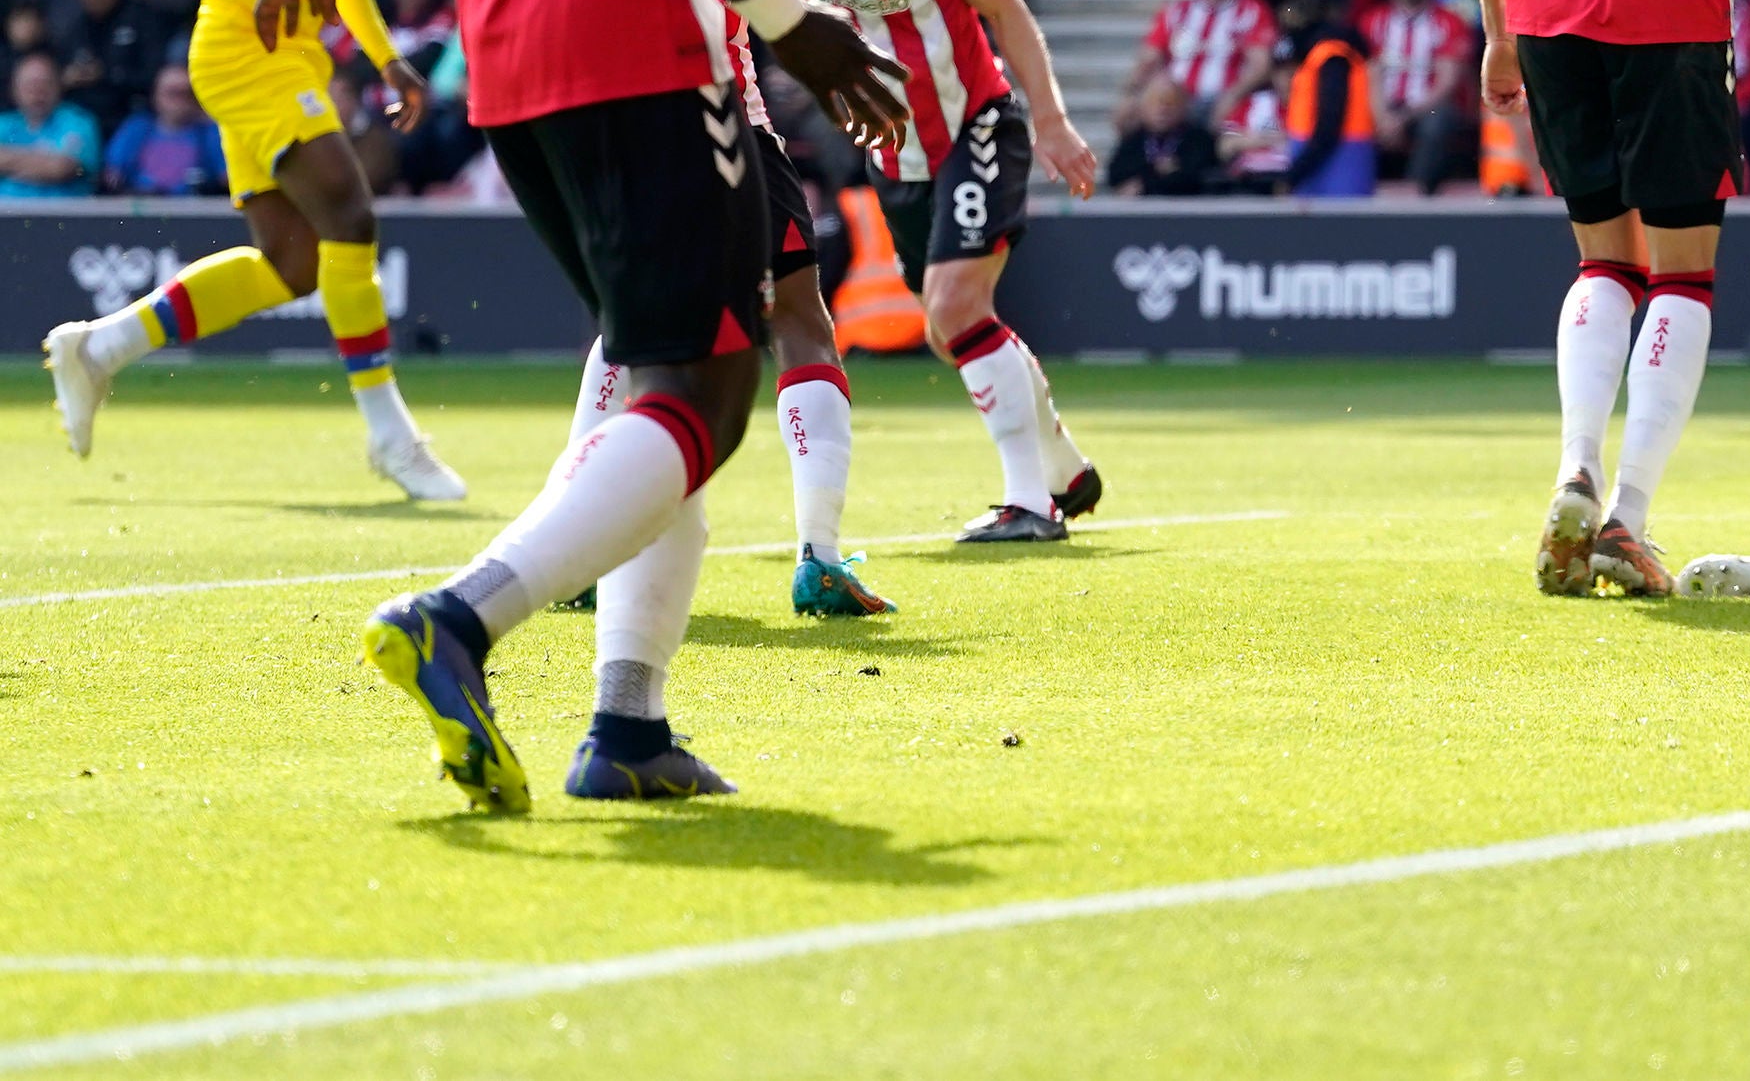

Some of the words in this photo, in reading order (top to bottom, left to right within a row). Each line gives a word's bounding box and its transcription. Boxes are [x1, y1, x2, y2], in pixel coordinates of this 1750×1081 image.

[953, 181, 988, 229] 8
[1202, 246, 1456, 318] hummel
[788, 406, 808, 456] SAINTS
